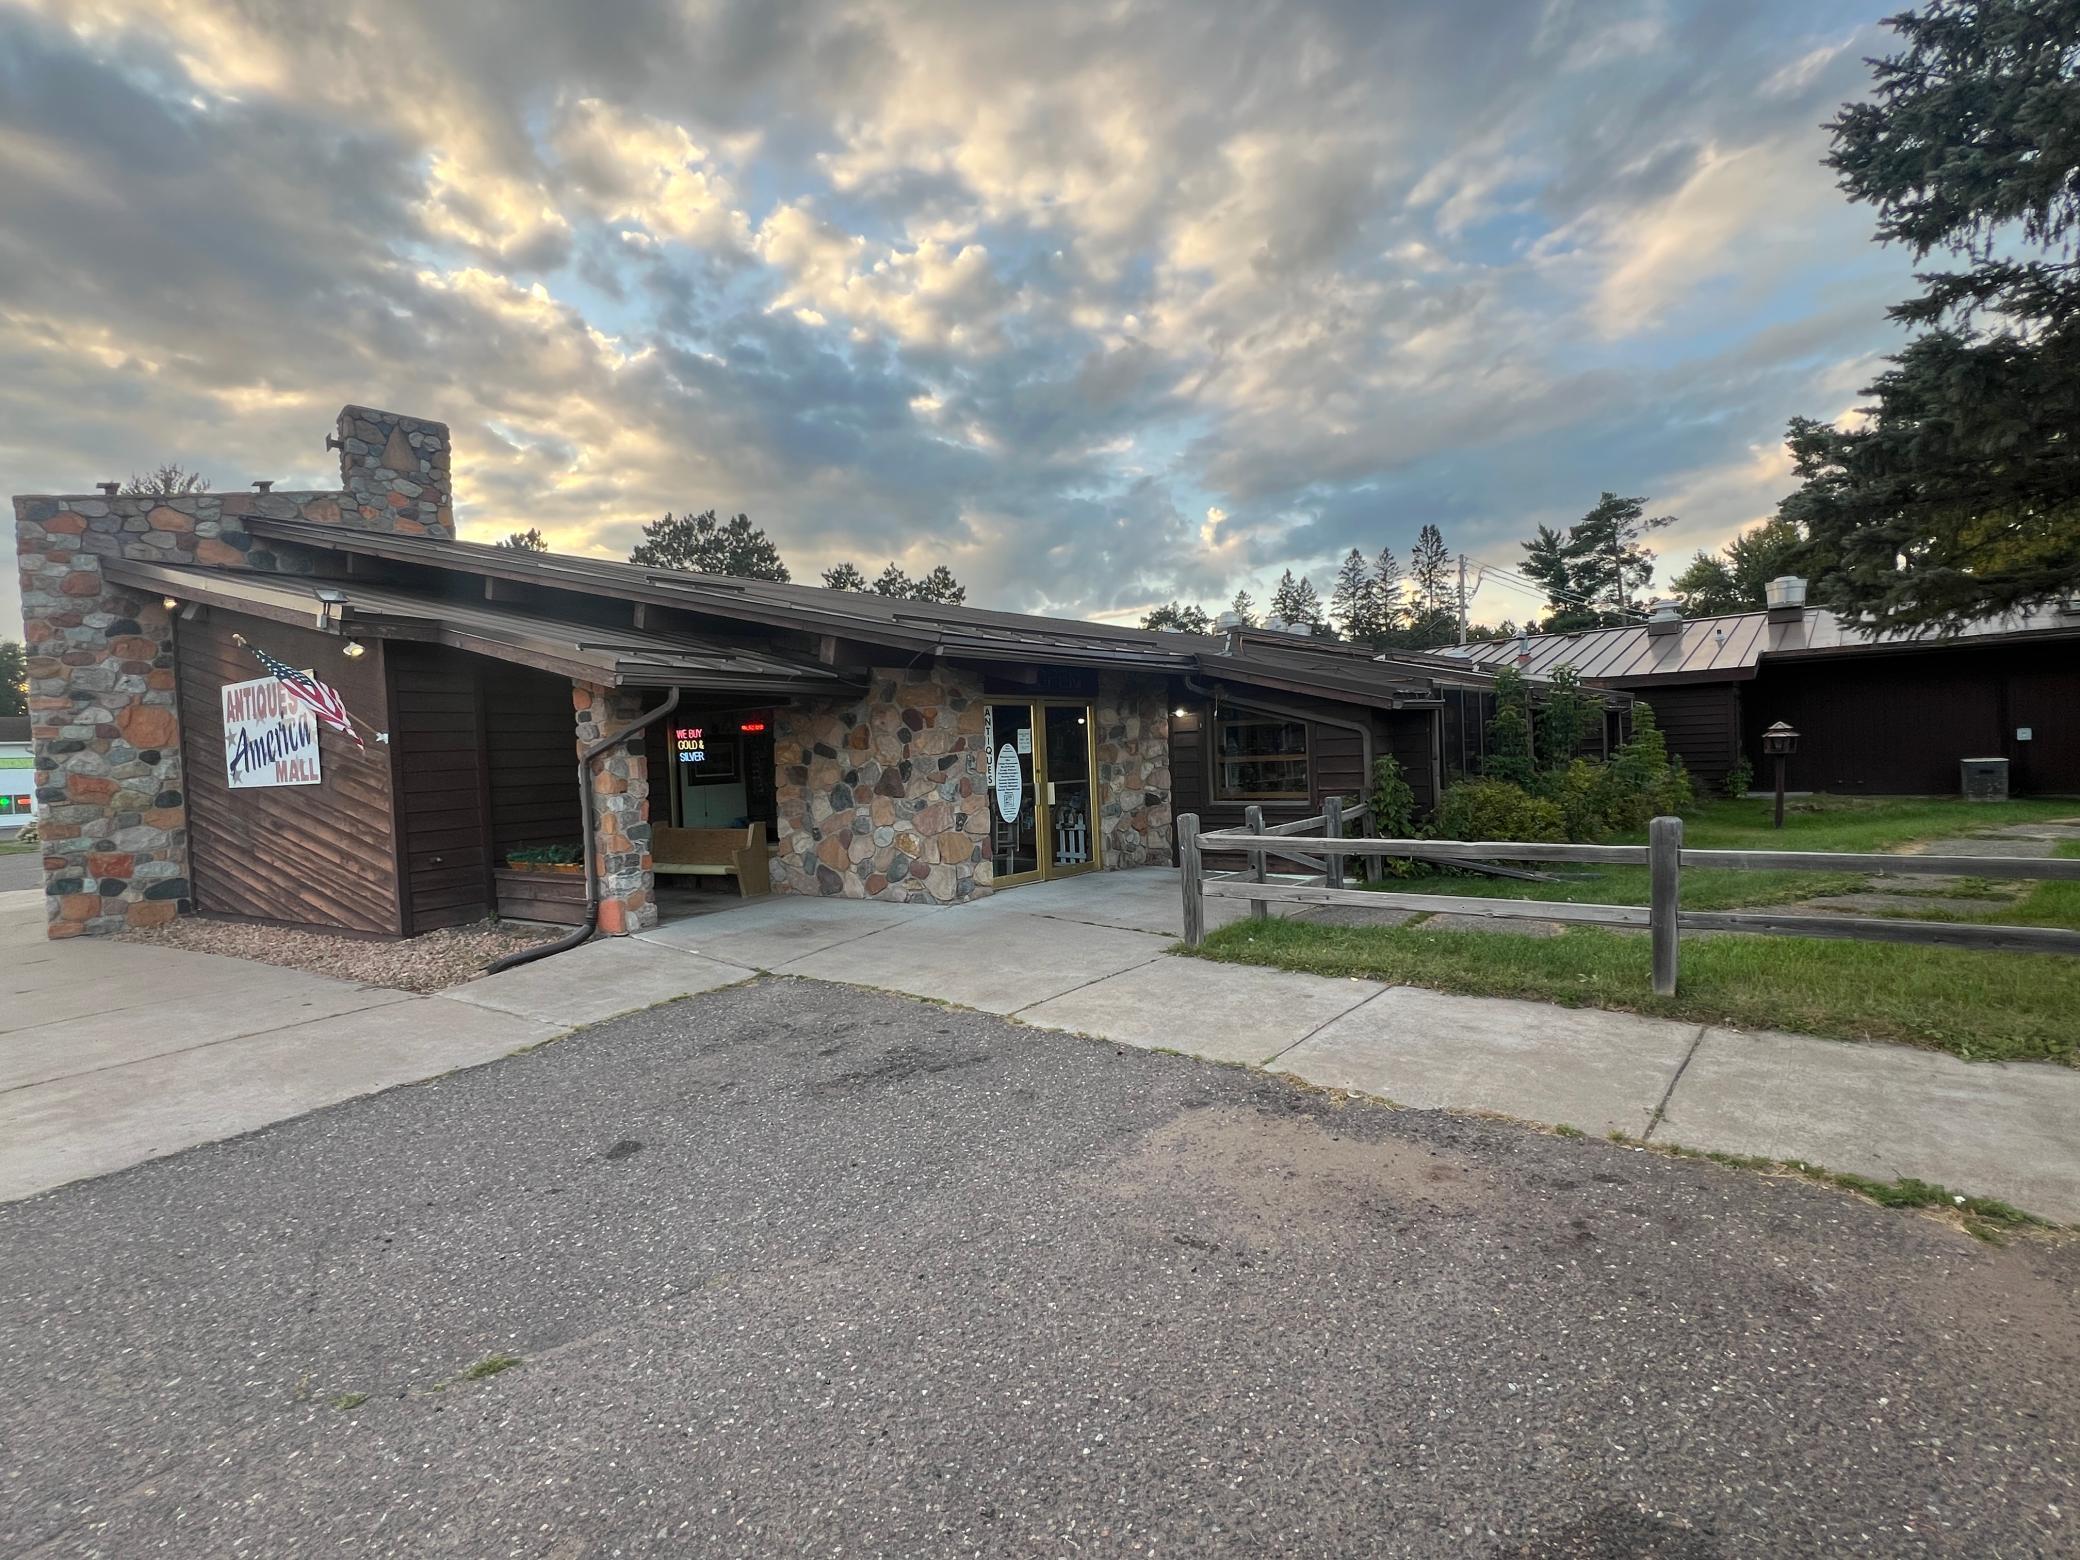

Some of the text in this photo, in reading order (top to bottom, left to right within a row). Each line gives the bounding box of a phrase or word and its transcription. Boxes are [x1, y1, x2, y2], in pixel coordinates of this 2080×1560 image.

[226, 682, 298, 723] ANTIQUES
[230, 711, 311, 773] America
[676, 729, 702, 739] WE BUY
[678, 740, 705, 750] GOLD &
[984, 708, 993, 784] ANTIQUES
[680, 751, 705, 762] SILVER
[276, 758, 319, 783] MALL
